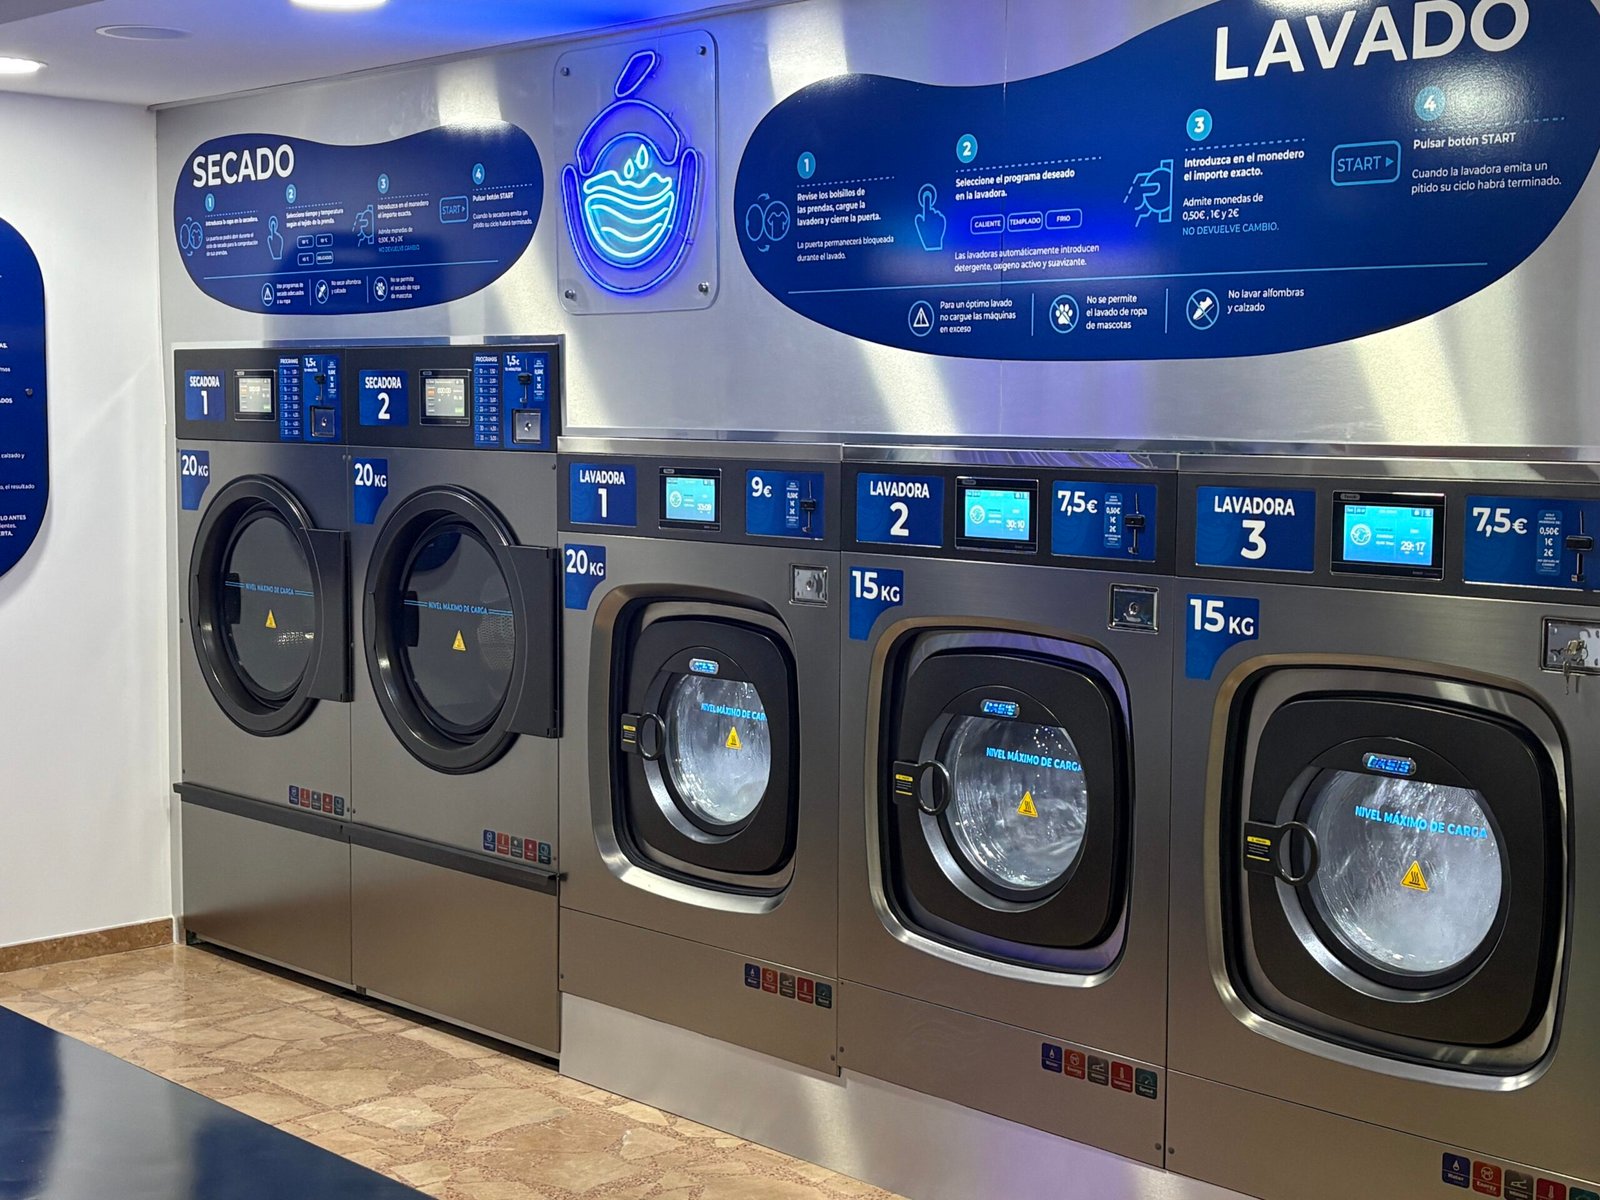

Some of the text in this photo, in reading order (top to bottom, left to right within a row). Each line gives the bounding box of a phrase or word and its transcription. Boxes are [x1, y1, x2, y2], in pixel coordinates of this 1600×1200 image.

[1215, 0, 1529, 81] LAVADO
[1424, 95, 1436, 111] 4
[1194, 117, 1204, 133] 3
[963, 142, 971, 156] 2
[1414, 133, 1516, 149] Pulsar botón START
[193, 144, 294, 188] SECADO
[804, 158, 809, 172] 1
[1185, 150, 1304, 168] Introduzca en el monedero
[1338, 156, 1381, 172] START
[956, 169, 1075, 187] Seleccione el programa deseado
[1184, 167, 1263, 182] el importe exacto.
[1412, 161, 1547, 179] Cuando la lavadora emita un
[1411, 176, 1561, 195] pitido su ciclo habrá terminado.
[797, 188, 865, 202] Revise los bolsillos de
[956, 189, 1007, 200] en la lavadora.
[1183, 193, 1263, 207] Admite monedas de
[442, 205, 460, 215] START
[797, 201, 865, 214] las prendas, cargue la
[1183, 208, 1239, 221] 0,50€ 1€ y 2€
[797, 212, 881, 226] lavadora y cierre la puerta.
[975, 220, 1001, 228] CALIENTE
[1010, 217, 1040, 225] TEMPLADO
[1183, 222, 1279, 236] NO DEVUELVE CAMBIO.
[797, 235, 894, 249] La puerta permanecerá bloqueada
[797, 254, 819, 262] durante
[827, 252, 846, 260] lavado.
[955, 244, 1099, 260] Las lavadoras automáticamente introducen
[955, 258, 1086, 273] detergente, oxígeno activo y suavizante.
[1087, 295, 1096, 304] No
[1108, 294, 1137, 305] permite
[1229, 288, 1304, 298] No lavar alfombras
[940, 301, 954, 309] Para
[966, 300, 989, 309] óptimo
[991, 299, 1012, 307] lavado
[1087, 307, 1147, 317] el lavado de ropa
[1227, 303, 1265, 314] y calzado
[950, 313, 972, 322] cargue
[984, 312, 1016, 321] máquinas
[1086, 320, 1131, 330] de mascotas
[190, 376, 220, 388] SECADORA
[365, 376, 402, 389] SECADORA
[201, 391, 208, 415] 1
[378, 392, 390, 419] 2
[182, 455, 208, 477] 20 KG
[355, 463, 386, 487] 20 KG
[579, 469, 625, 485] LAVADORA
[751, 476, 772, 498] 9€
[870, 480, 930, 499] LAVADORA
[598, 488, 607, 518] 1
[1057, 490, 1098, 516] 7,5€
[1214, 496, 1295, 516] LAVADORA
[889, 502, 909, 536] 2
[1472, 506, 1527, 537] 7,5€
[1540, 527, 1559, 535] 0,50€
[1240, 519, 1267, 560] 3
[1400, 541, 1426, 551] 29:17
[1545, 538, 1553, 546] 1€
[1544, 549, 1553, 557] 2€
[566, 549, 604, 576] 20 KG
[852, 570, 900, 602] 15 KG
[1190, 599, 1254, 636] 15 KG
[987, 747, 1006, 760] NIVEL
[1008, 750, 1039, 765] MÁXIMO
[1041, 757, 1052, 767] DE
[1355, 806, 1488, 839] NIVEL MÁXIMO DE CARGA
